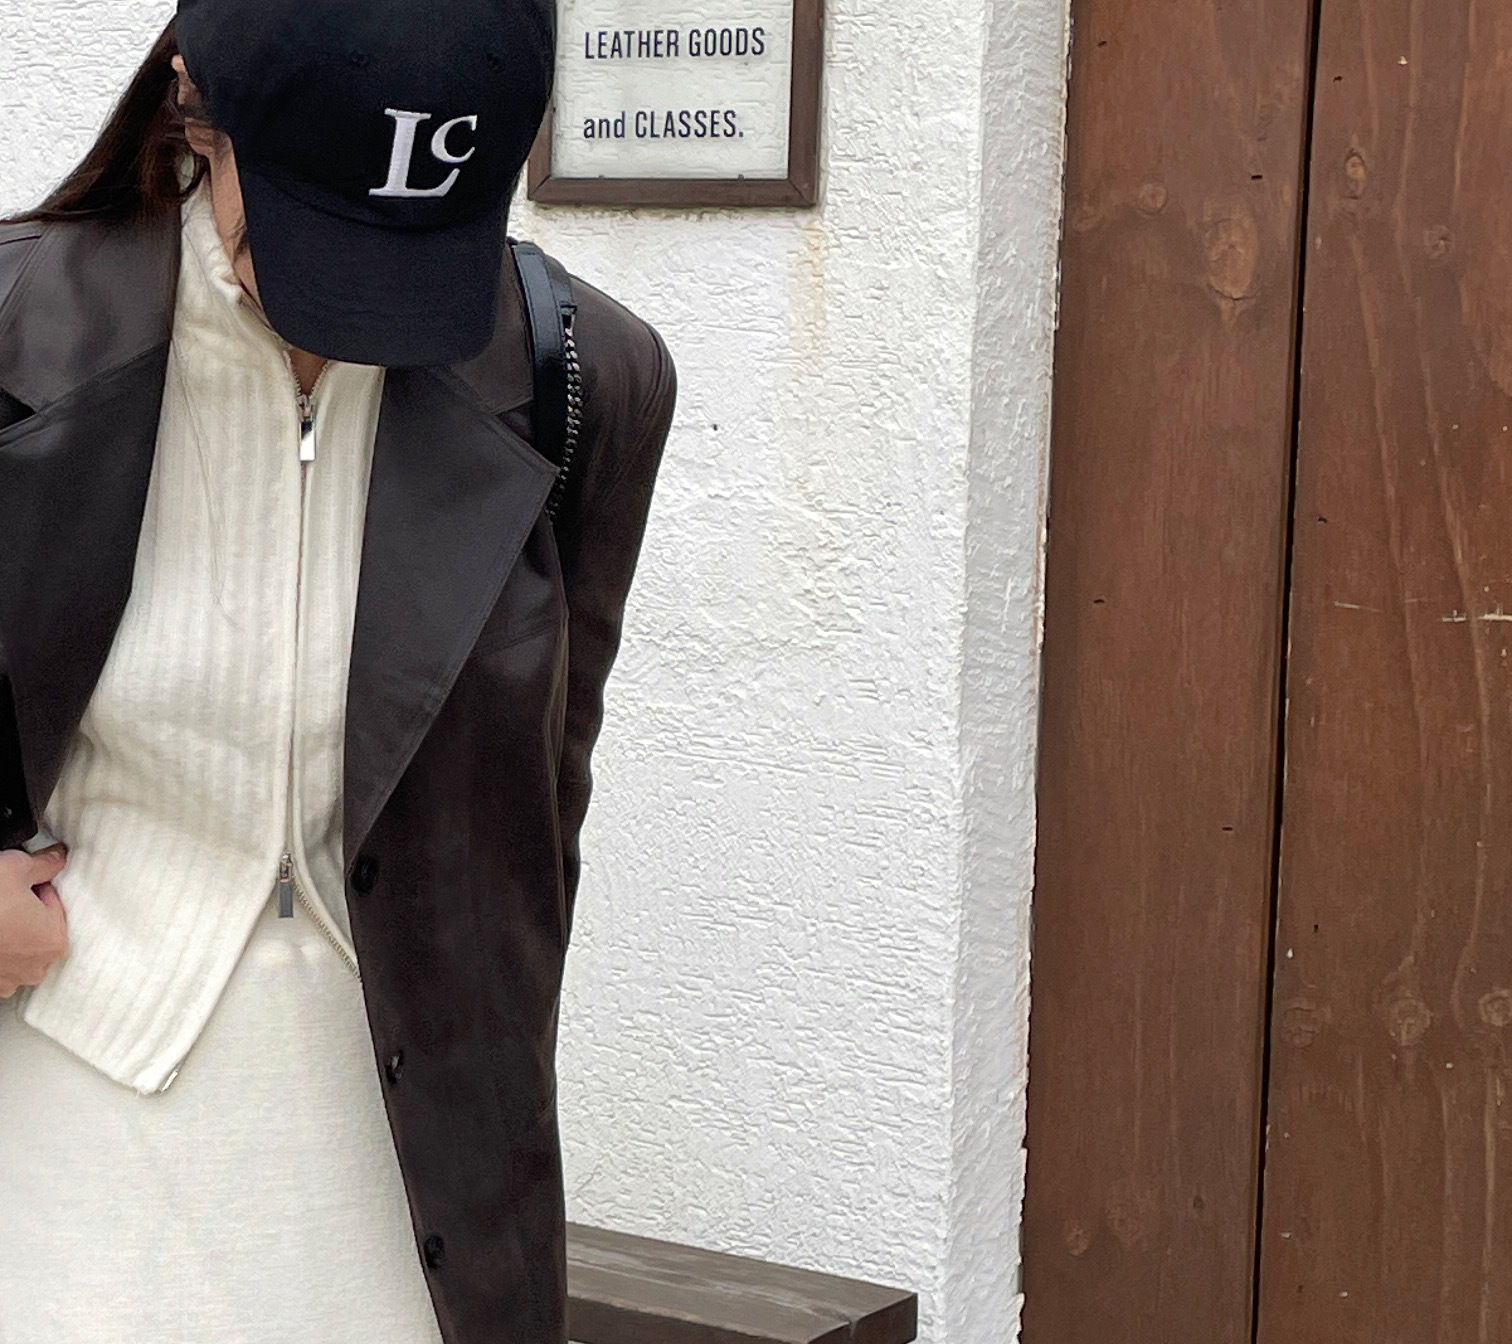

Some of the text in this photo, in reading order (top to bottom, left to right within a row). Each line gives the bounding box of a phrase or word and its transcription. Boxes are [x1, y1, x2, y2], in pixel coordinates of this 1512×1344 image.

[585, 26, 765, 60] LEATHER GOODS
[583, 109, 744, 139] and CLASSES.
